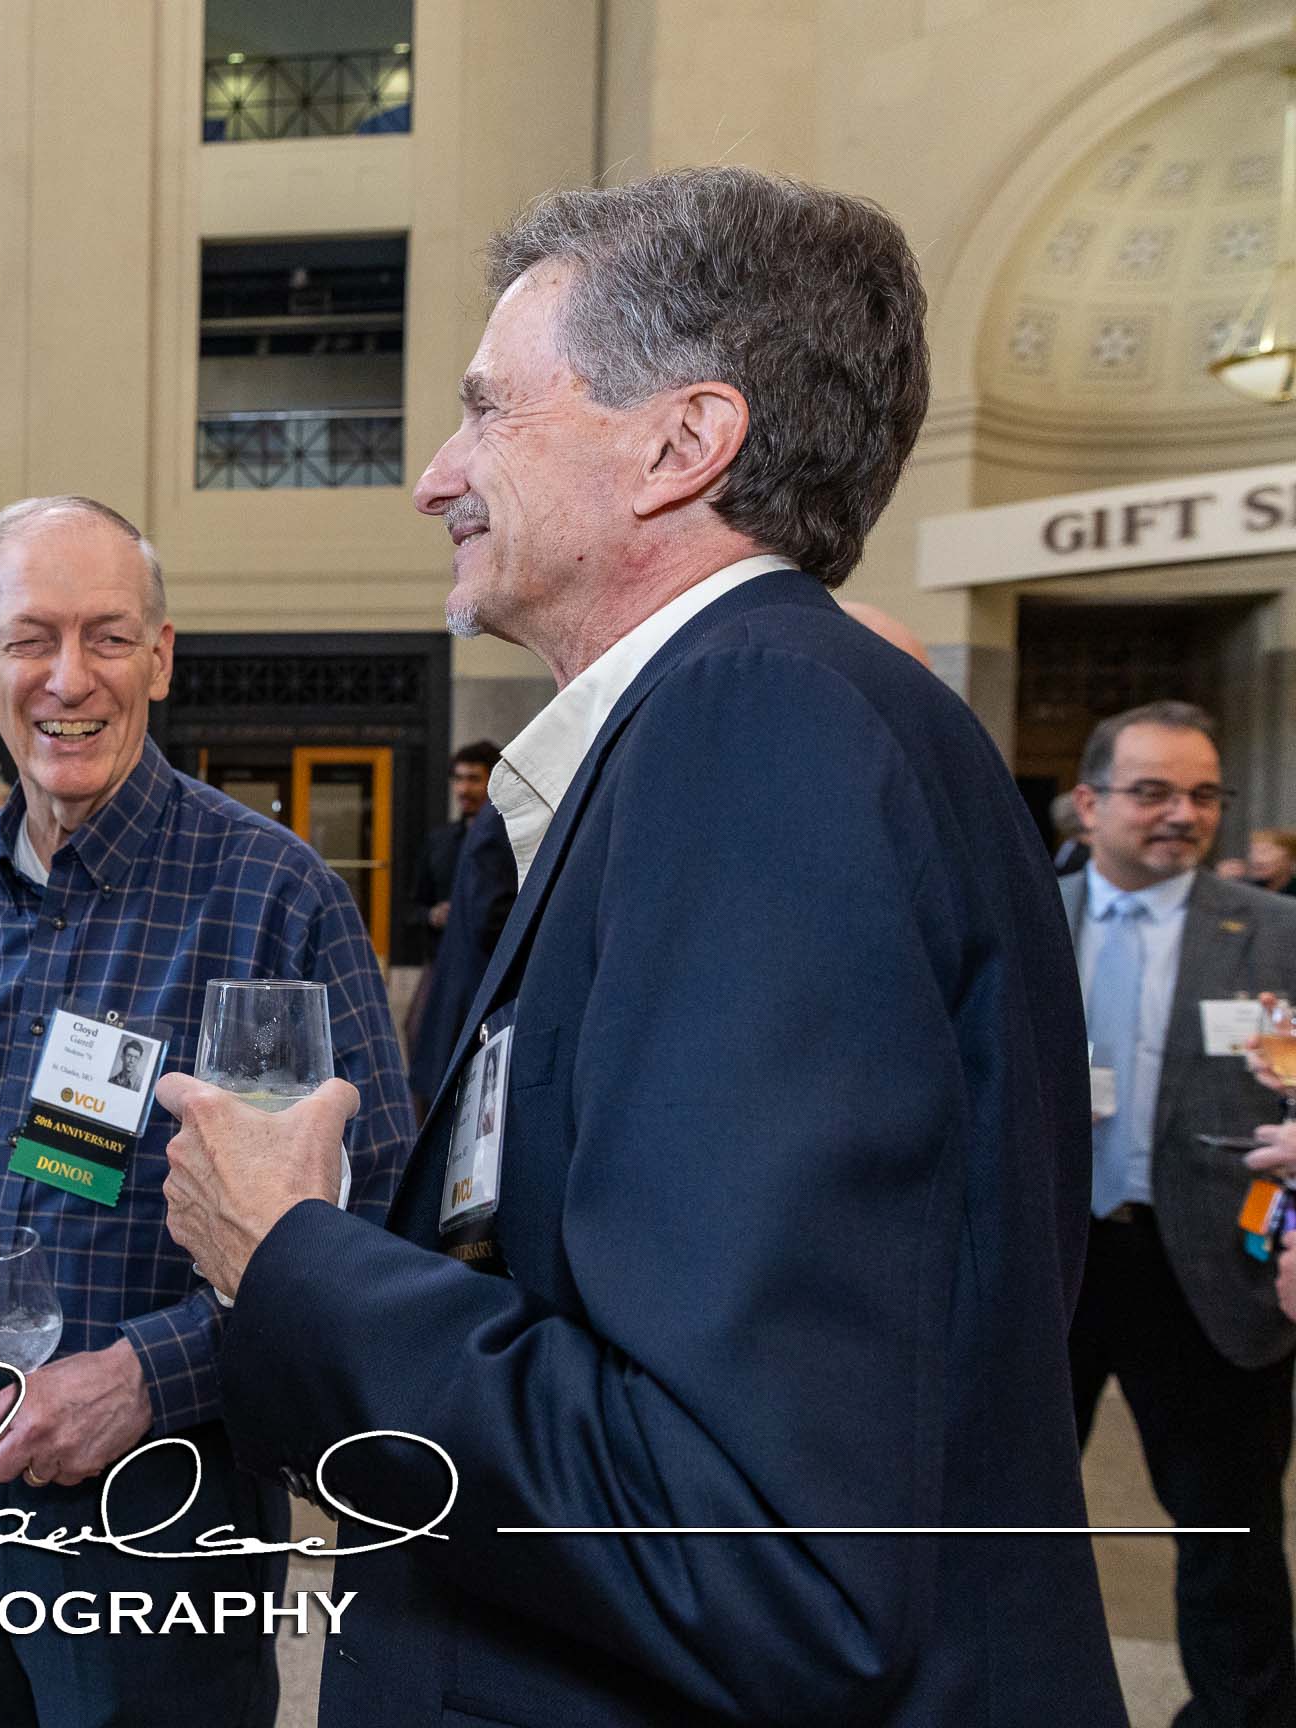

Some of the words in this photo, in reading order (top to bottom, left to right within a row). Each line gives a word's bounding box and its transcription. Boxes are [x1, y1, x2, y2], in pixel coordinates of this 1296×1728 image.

[1042, 493, 1216, 555] GIFT
[1242, 482, 1296, 534] S
[73, 1021, 99, 1038] Cloyd
[74, 1090, 106, 1113] VCU
[33, 1114, 54, 1130] 50th
[53, 1123, 126, 1154] ANNIVERSARY
[36, 1155, 95, 1187] DONOR
